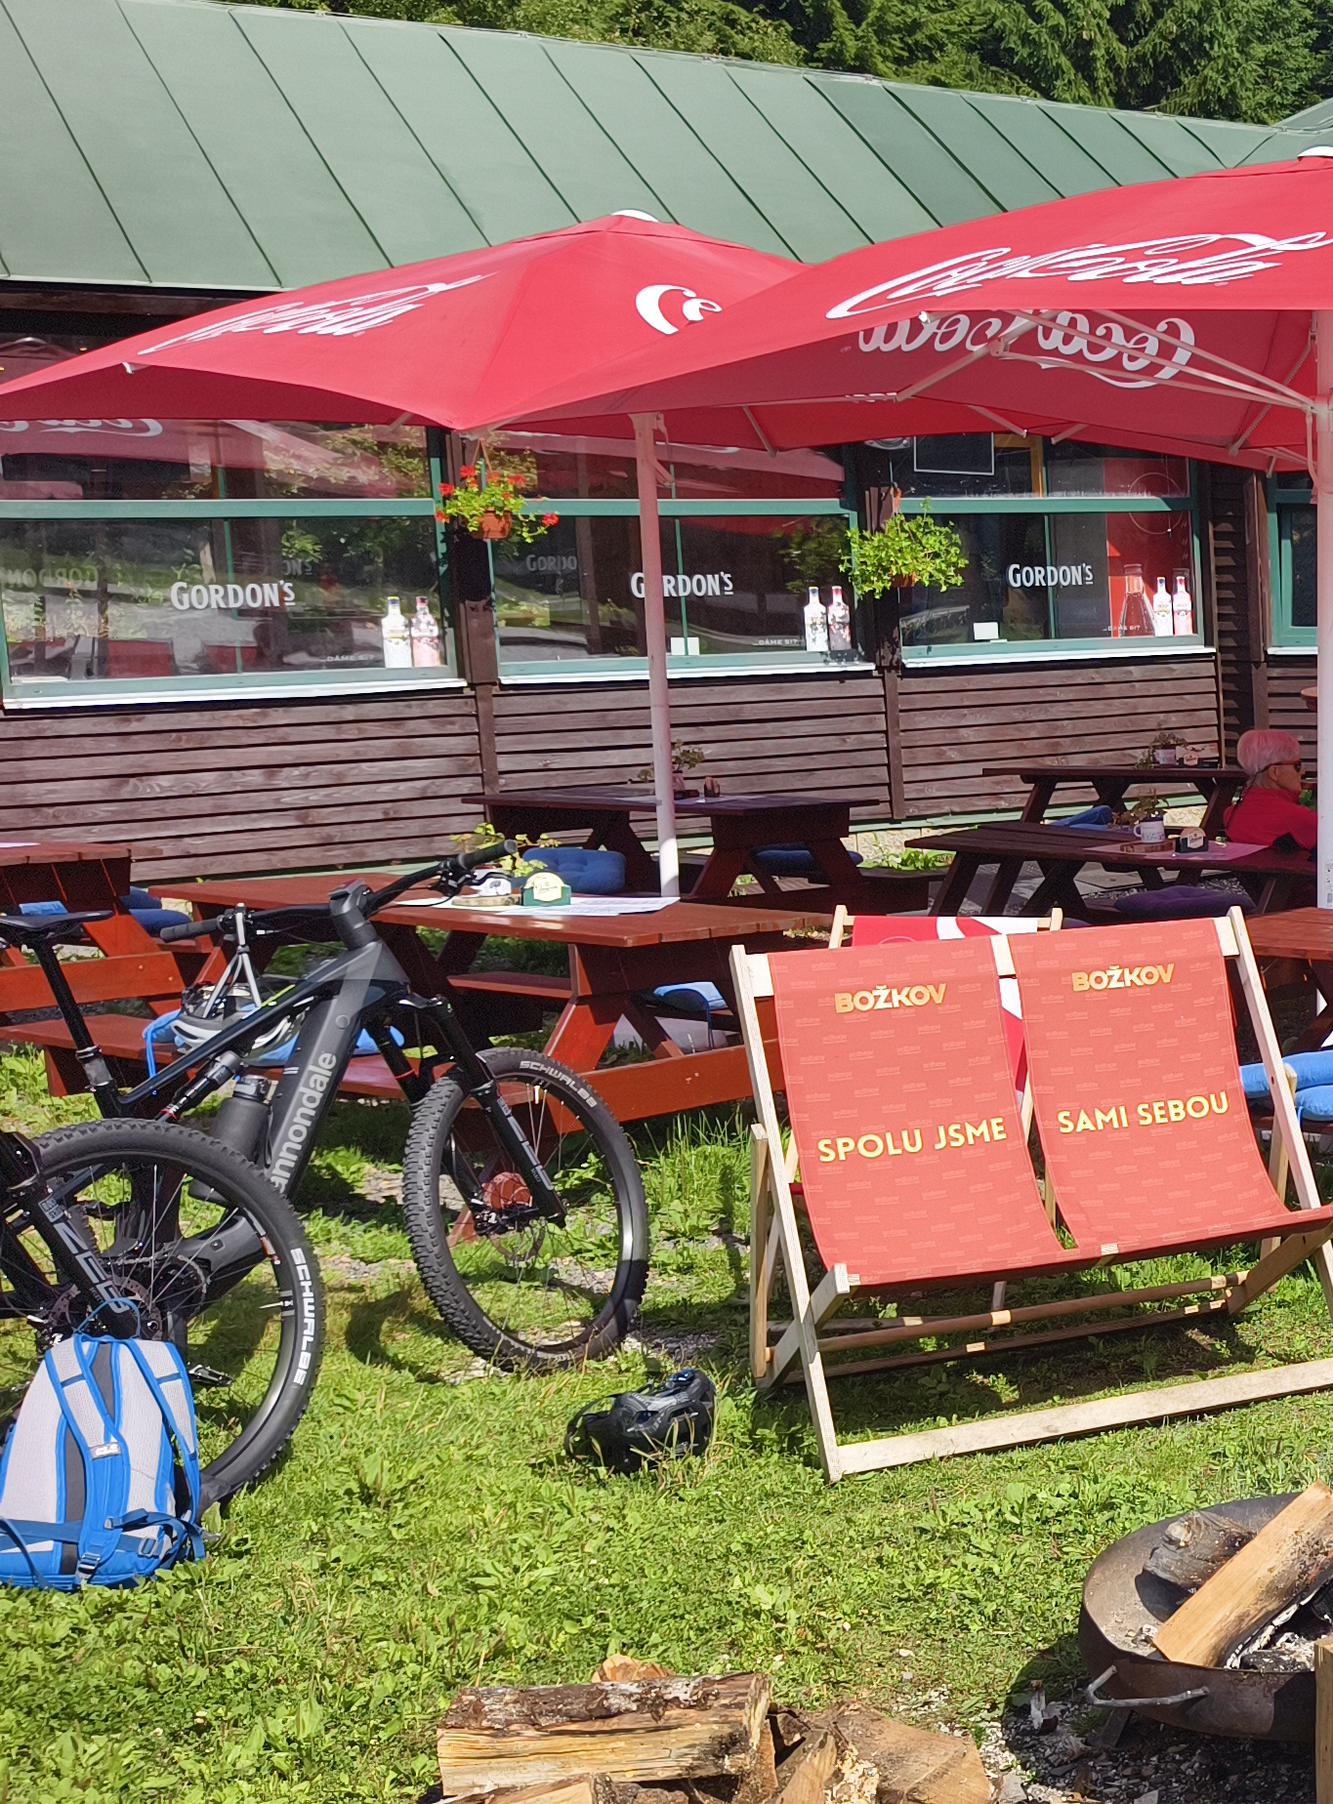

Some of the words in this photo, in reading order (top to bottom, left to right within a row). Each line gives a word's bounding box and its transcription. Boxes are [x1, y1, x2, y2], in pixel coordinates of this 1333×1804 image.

[630, 571, 734, 599] GRDON'S
[1008, 562, 1094, 588] GORDON'S
[170, 580, 296, 611] GORDON'S
[1071, 963, 1175, 992] BOŽKOV
[834, 983, 947, 1013] BOŽKOV
[519, 1060, 598, 1108] SCHWALBE
[270, 1051, 337, 1194] annondale
[1057, 1105, 1129, 1135] SAMI
[1138, 1091, 1229, 1127] SEBOU
[816, 1128, 923, 1163] SPOLU
[933, 1117, 1007, 1151] JSME
[291, 1248, 316, 1385] SCHWALBE
